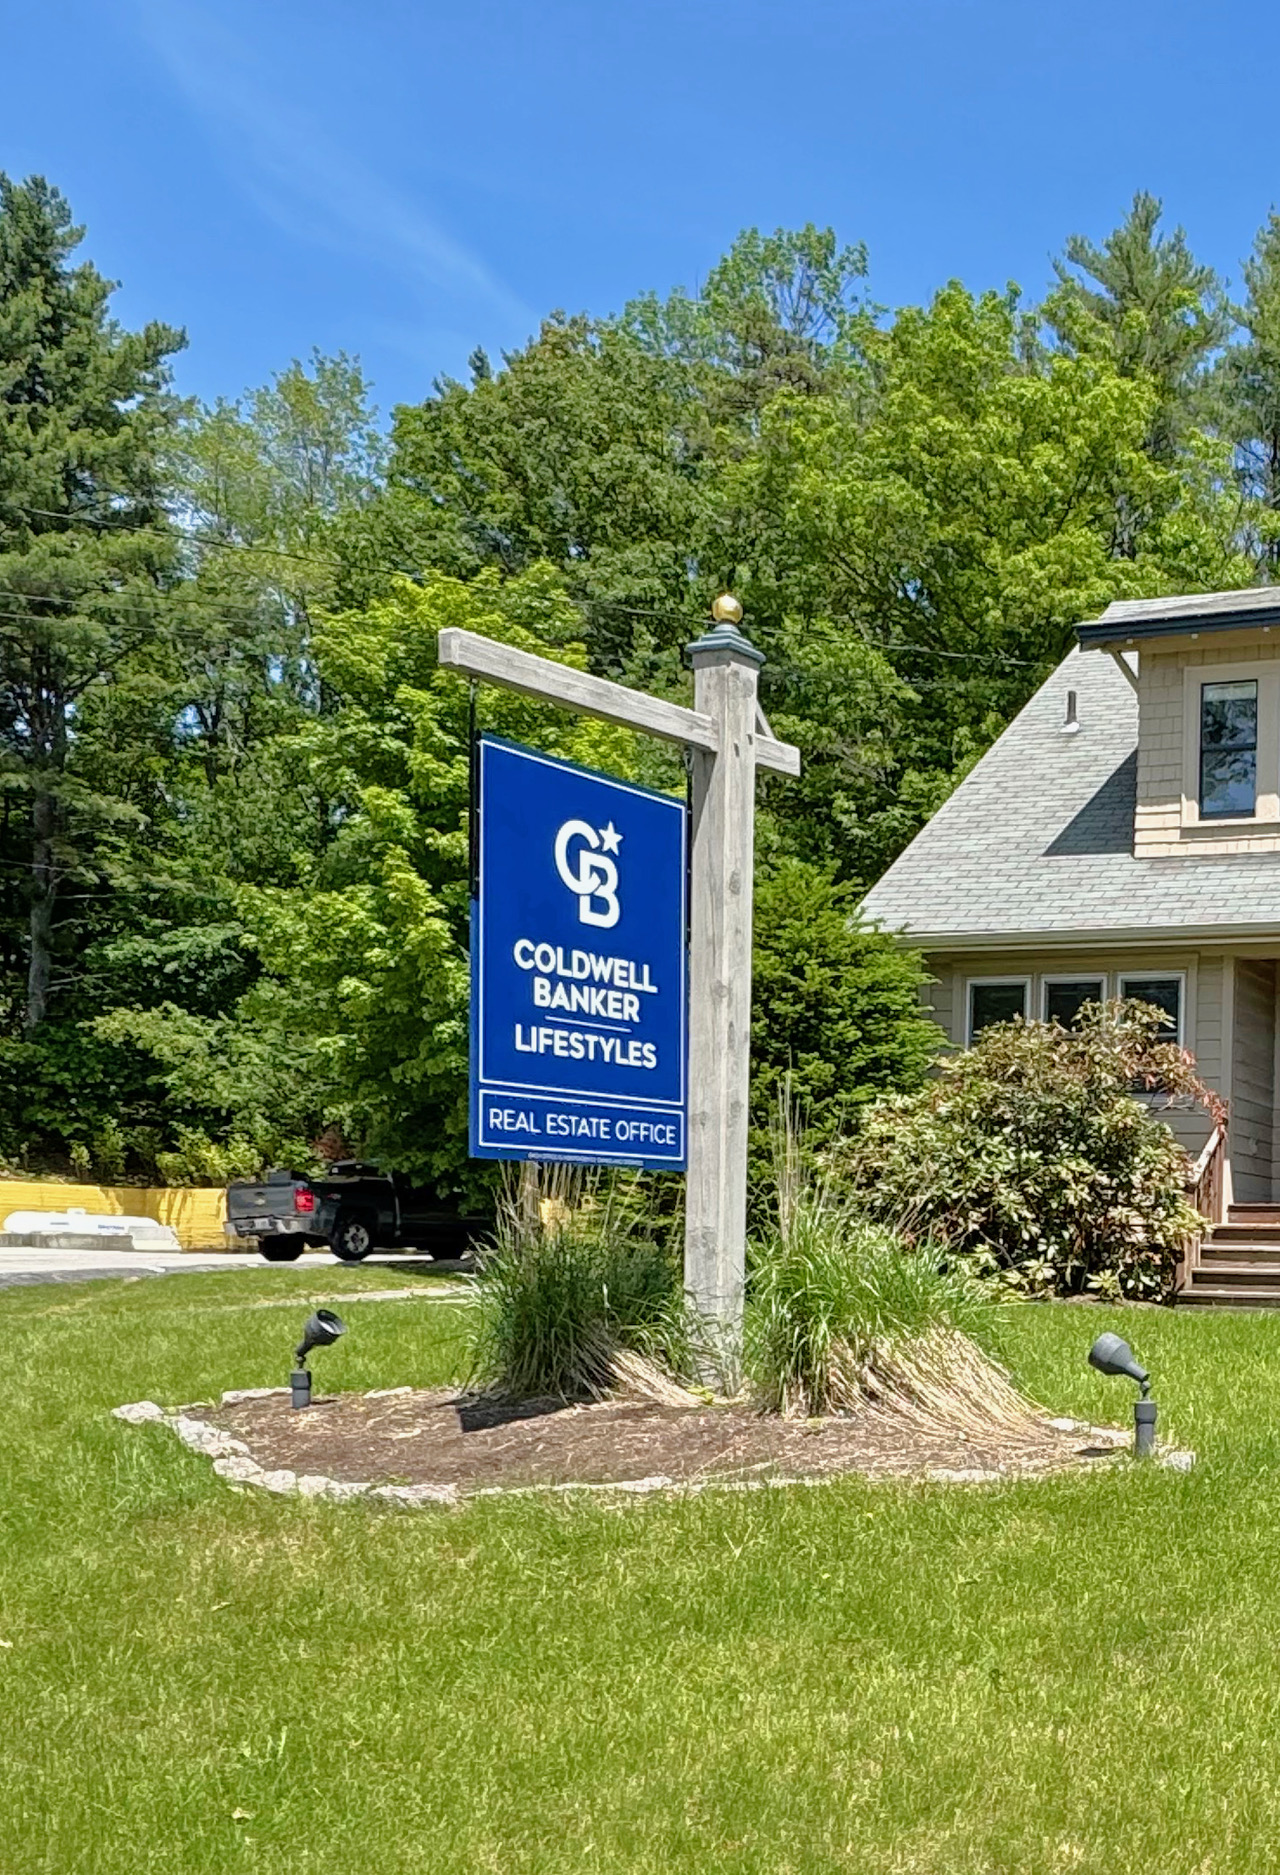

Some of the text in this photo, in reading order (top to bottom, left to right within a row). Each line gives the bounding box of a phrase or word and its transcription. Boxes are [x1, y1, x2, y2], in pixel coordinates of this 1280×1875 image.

[513, 938, 658, 993] COLDWELL
[533, 976, 640, 1023] BANKER
[515, 1023, 657, 1069] LIFESTYLES
[489, 1108, 676, 1145] REAL ESTATE OFFICE
